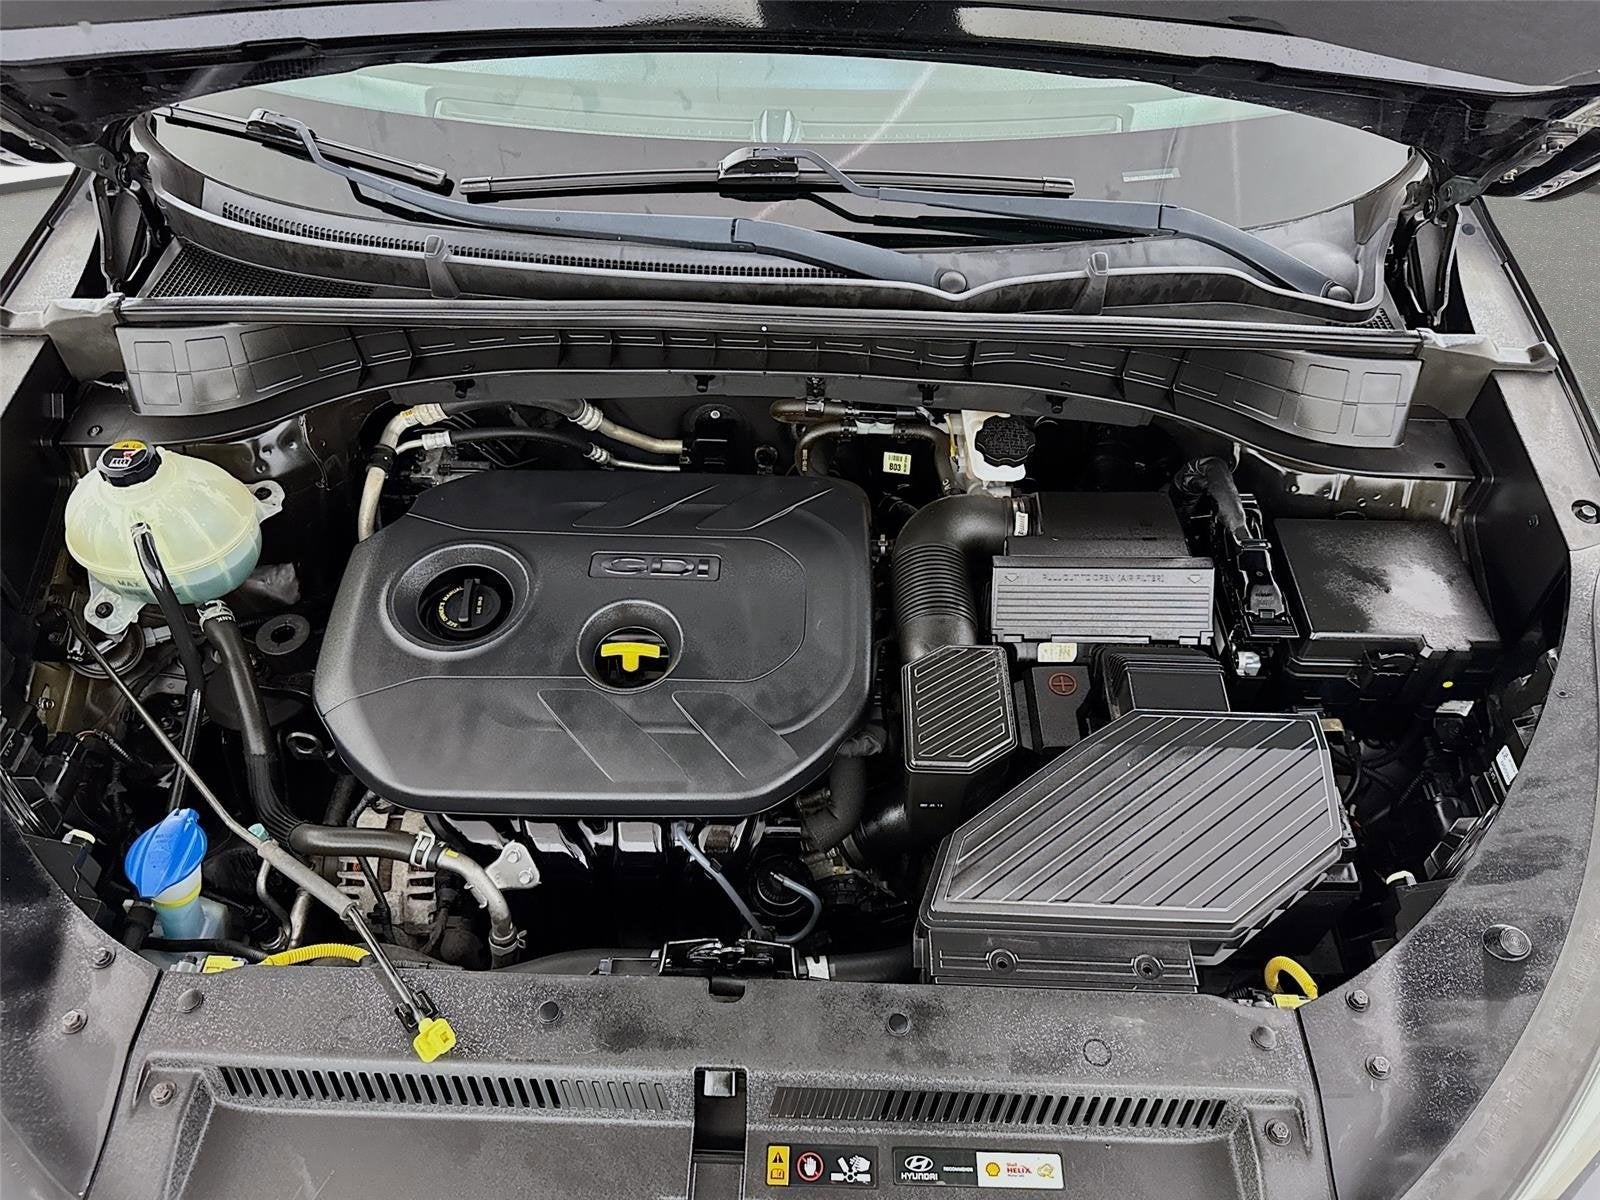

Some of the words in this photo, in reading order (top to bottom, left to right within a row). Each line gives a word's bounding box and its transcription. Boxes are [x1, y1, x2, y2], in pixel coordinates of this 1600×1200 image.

[601, 557, 709, 577] GDI
[1093, 574, 1114, 582] OPEN
[1006, 1166, 1032, 1174] HELIX
[901, 1172, 938, 1180] HYUNDAI
